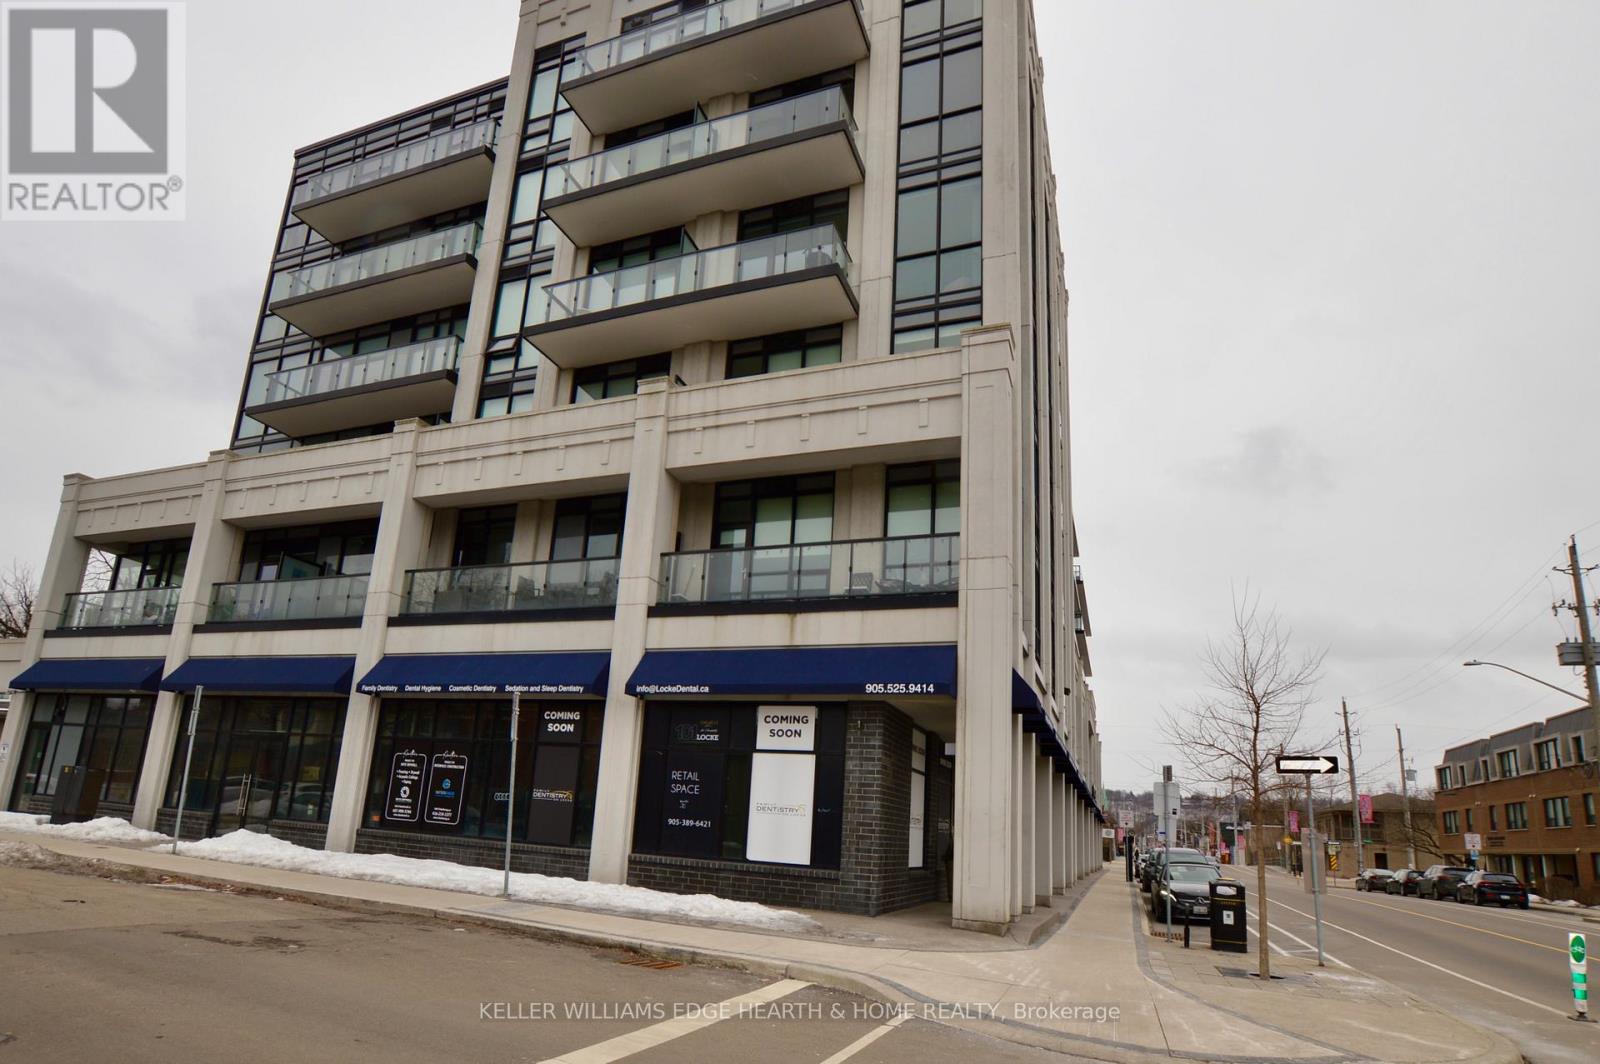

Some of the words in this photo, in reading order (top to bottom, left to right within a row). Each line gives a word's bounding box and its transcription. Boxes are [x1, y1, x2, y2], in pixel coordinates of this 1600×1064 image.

[361, 684, 376, 692] Family
[377, 684, 398, 693] Dentistry
[404, 684, 420, 692] Dental
[421, 684, 441, 693] Hygiene
[448, 684, 472, 692] Cosmetic
[473, 684, 497, 693] Dentistry
[505, 684, 528, 692] Sedation
[529, 684, 541, 692] and
[541, 684, 557, 693] Sleep
[558, 684, 584, 693] Dentistry
[865, 684, 934, 693] 905.525.9414
[544, 711, 580, 720] COMING
[764, 715, 809, 724] COMING
[547, 723, 574, 732] SOON
[769, 728, 802, 738] SOON
[671, 770, 700, 781] RETAIL
[670, 783, 700, 795] SPACE
[668, 818, 711, 828] 905-389-6421
